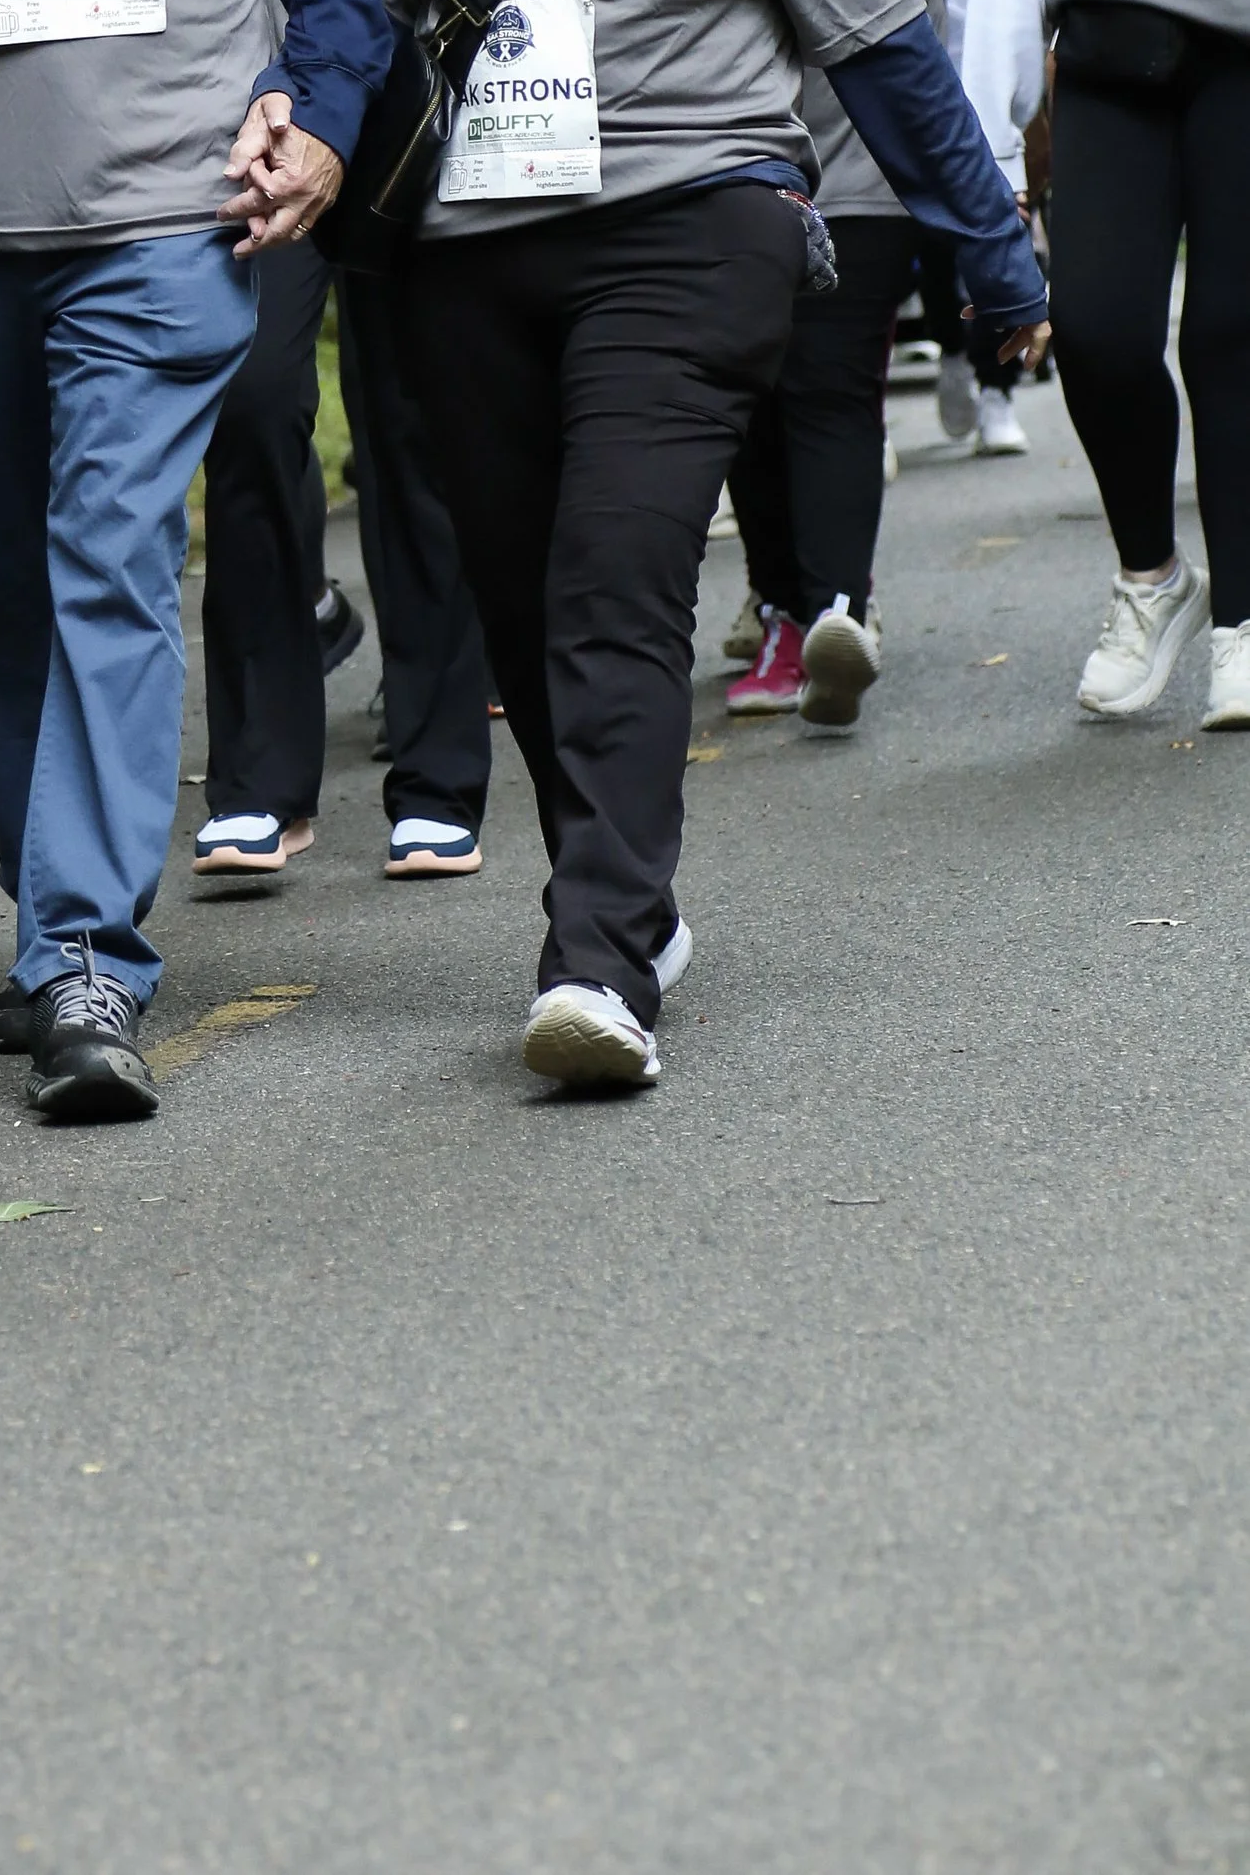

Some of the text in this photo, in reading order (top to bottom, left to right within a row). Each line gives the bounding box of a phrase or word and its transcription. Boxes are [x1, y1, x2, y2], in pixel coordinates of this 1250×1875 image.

[499, 30, 529, 39] STRONG
[459, 77, 593, 107] AK STRONG
[469, 114, 553, 138] Di DUFFY
